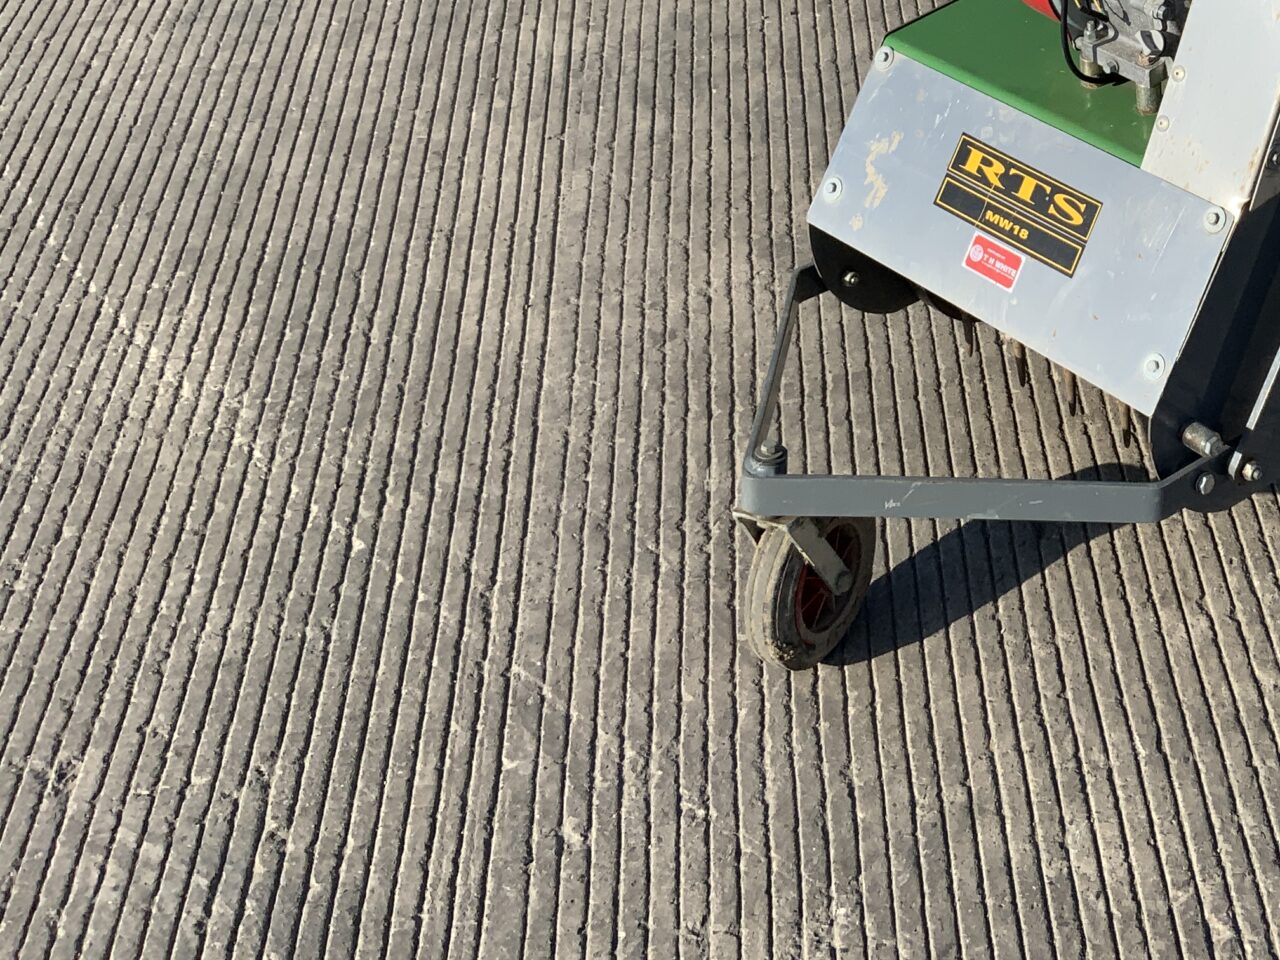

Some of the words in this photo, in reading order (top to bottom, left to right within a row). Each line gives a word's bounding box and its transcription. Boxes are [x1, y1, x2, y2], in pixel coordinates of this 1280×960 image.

[959, 145, 1087, 226] RTS
[985, 210, 1030, 240] MW18
[983, 253, 990, 261] T
[995, 259, 1018, 278] WHITE
